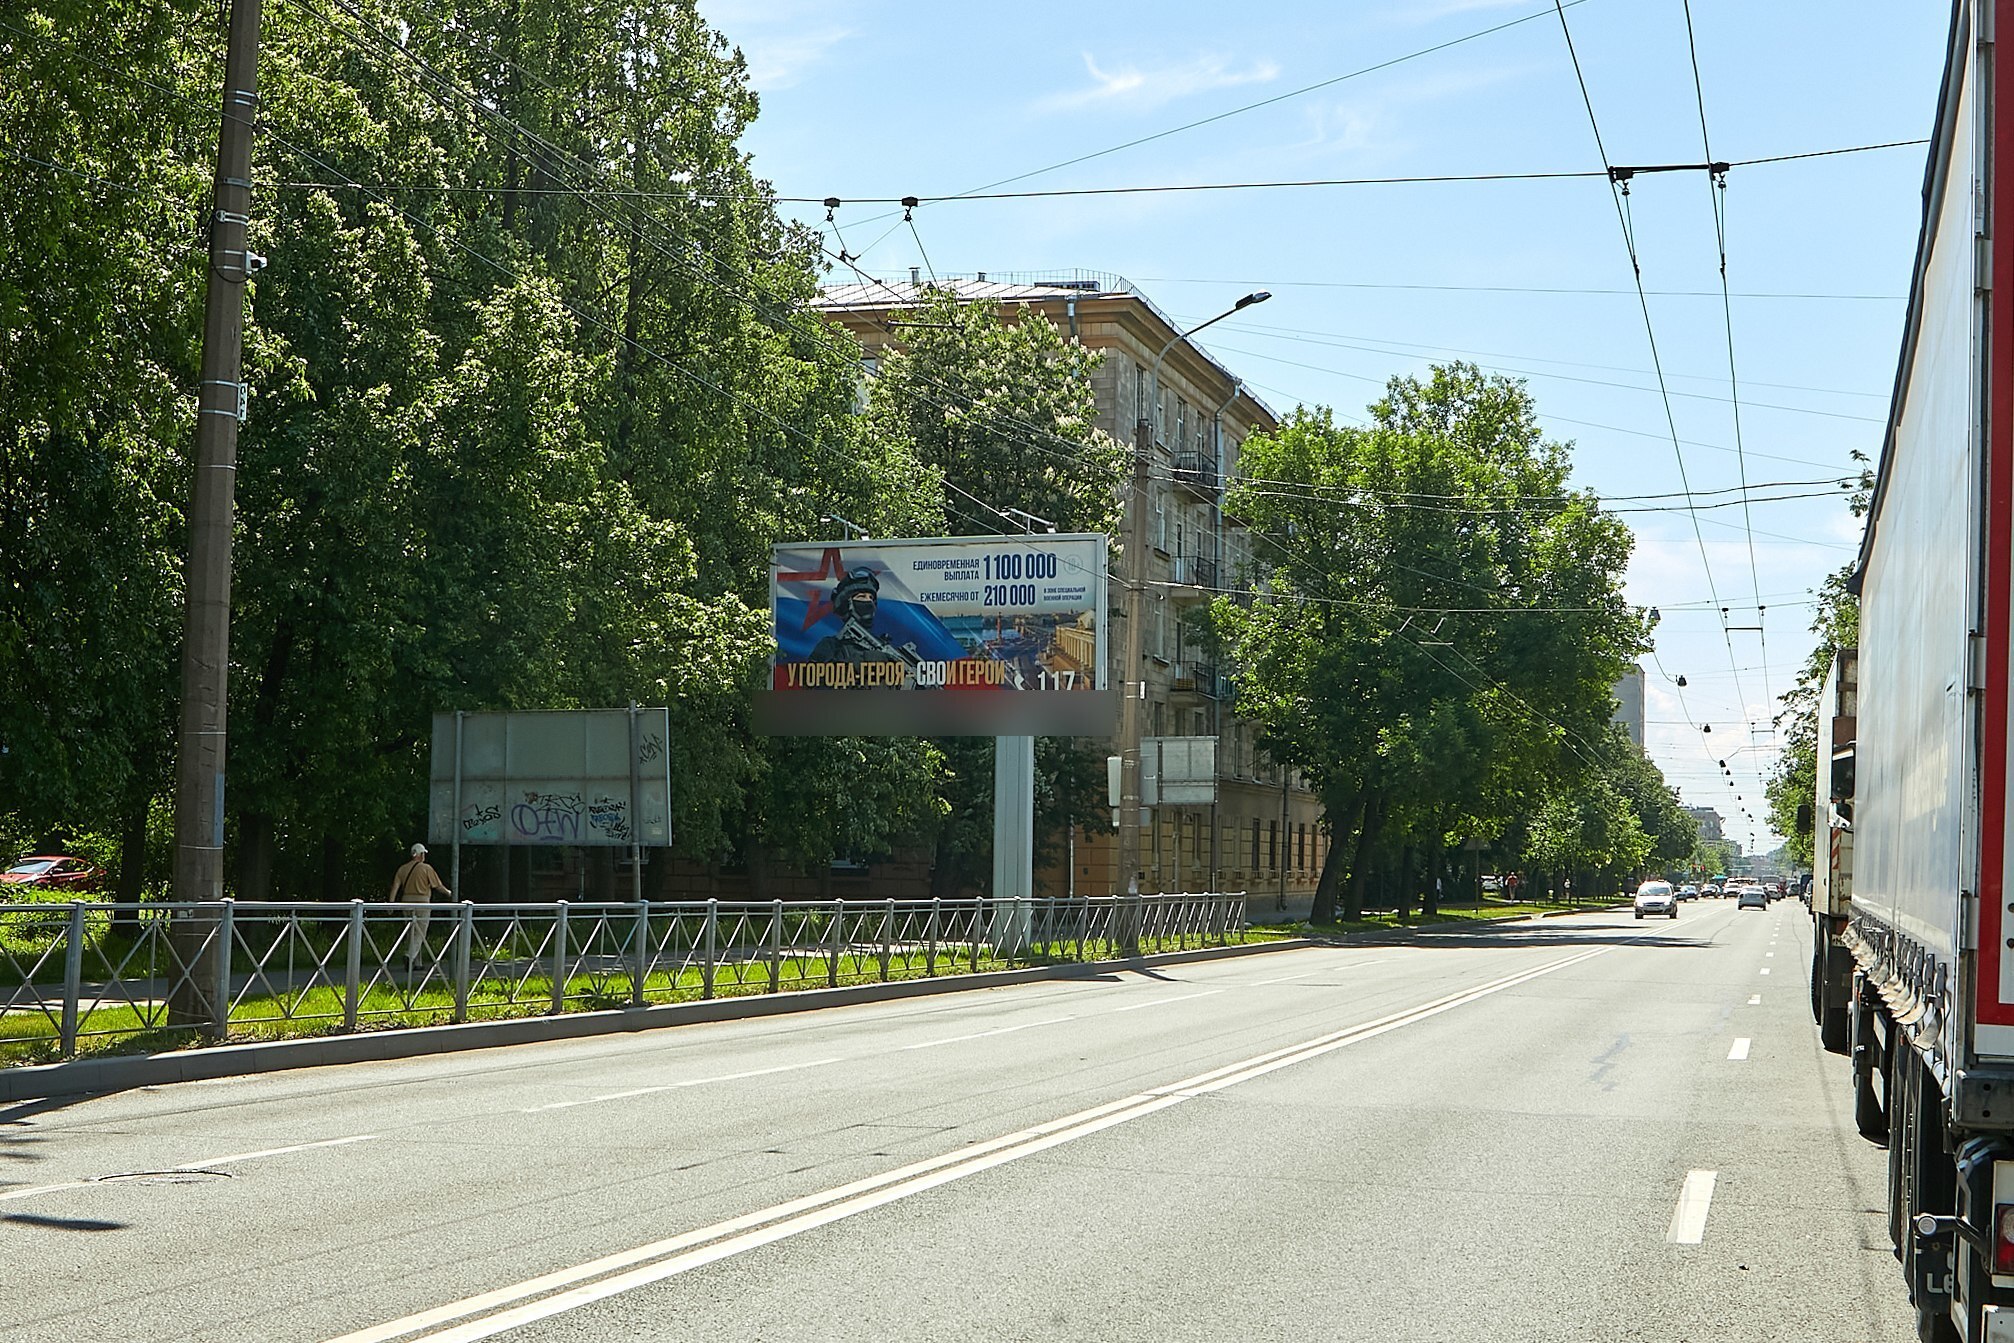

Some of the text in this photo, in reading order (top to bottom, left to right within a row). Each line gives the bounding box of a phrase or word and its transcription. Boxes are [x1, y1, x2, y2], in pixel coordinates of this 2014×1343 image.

[913, 558, 980, 571] ЕДИНОВРЕМЕННАЯ
[983, 552, 1057, 580] 1 100 000
[944, 570, 980, 581] ВЫПЛАТА
[920, 591, 979, 603] ЕЖЕМЕСЯЧНО ОТ
[983, 583, 1036, 607] 210 000
[787, 662, 798, 687] У
[799, 661, 905, 689] ГОРОДА-ГЕРОЯ
[916, 659, 957, 687] СВОИ
[959, 659, 1005, 686] ГЕРОИ
[1037, 670, 1075, 690] 117
